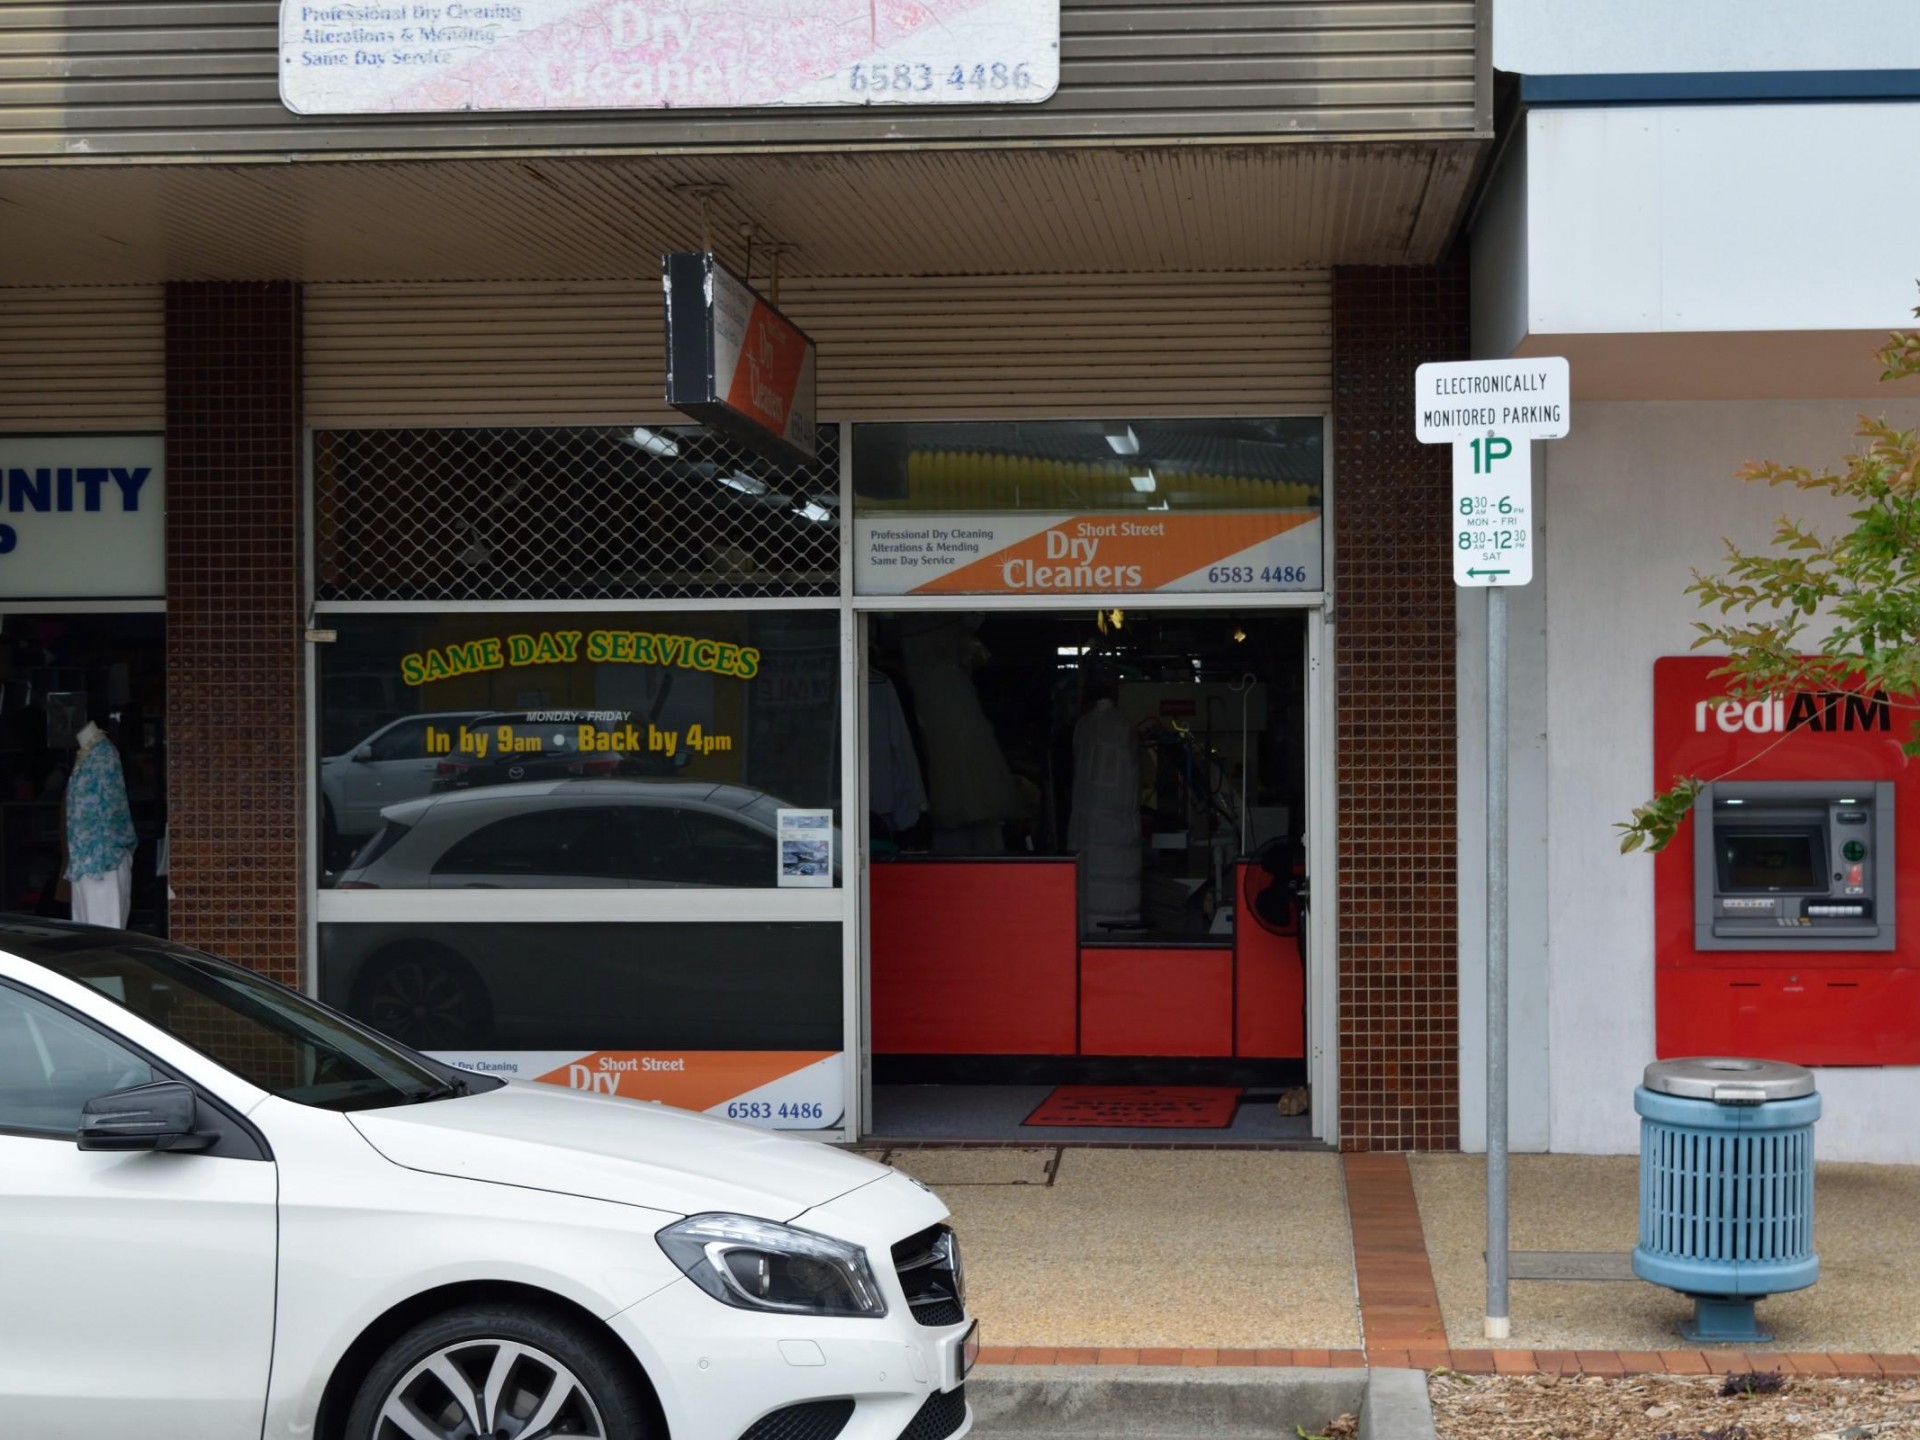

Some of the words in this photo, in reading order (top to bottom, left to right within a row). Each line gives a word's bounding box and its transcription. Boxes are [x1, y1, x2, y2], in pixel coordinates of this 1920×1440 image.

[302, 51, 348, 66] Same
[355, 50, 385, 68] Day
[850, 63, 934, 92] 6583
[947, 62, 1031, 90] 4486
[1436, 373, 1547, 395] ELECTRONICALLY
[1424, 408, 1496, 428] MONITORED
[1503, 404, 1561, 424] PARKING
[1470, 437, 1513, 474] 1P
[0, 467, 152, 513] NITY
[1078, 523, 1117, 536] Short
[1121, 523, 1165, 536] Street
[1467, 518, 1489, 526] MON
[1501, 517, 1517, 525] FRI
[871, 530, 929, 540] Professional
[933, 530, 947, 542] Dry
[951, 529, 994, 541] Cleaning
[871, 543, 922, 553] Alterations
[926, 543, 933, 552] &
[937, 543, 979, 554] Mending
[1047, 530, 1099, 565] Dry
[871, 556, 897, 566] Same
[901, 556, 917, 568] Day
[921, 556, 955, 566] Service
[1482, 552, 1502, 561] SAT
[1003, 559, 1142, 588] Cleaners
[1208, 567, 1253, 583] 6583
[1260, 566, 1306, 582] 4486
[401, 638, 504, 686] SAME
[508, 631, 582, 666] DAY
[587, 630, 760, 679] SERVICES
[526, 712, 578, 722] MONDAY
[587, 711, 631, 721] FRIDAY
[427, 726, 450, 752] In
[460, 726, 488, 758] by
[578, 724, 640, 751] Back
[649, 724, 678, 757] by
[476, 1061, 519, 1073] Cleaning
[599, 1057, 638, 1071] Short
[642, 1057, 685, 1071] Street
[569, 1064, 621, 1096] Dry
[727, 1103, 772, 1119] 6583
[778, 1102, 823, 1118] 4486
